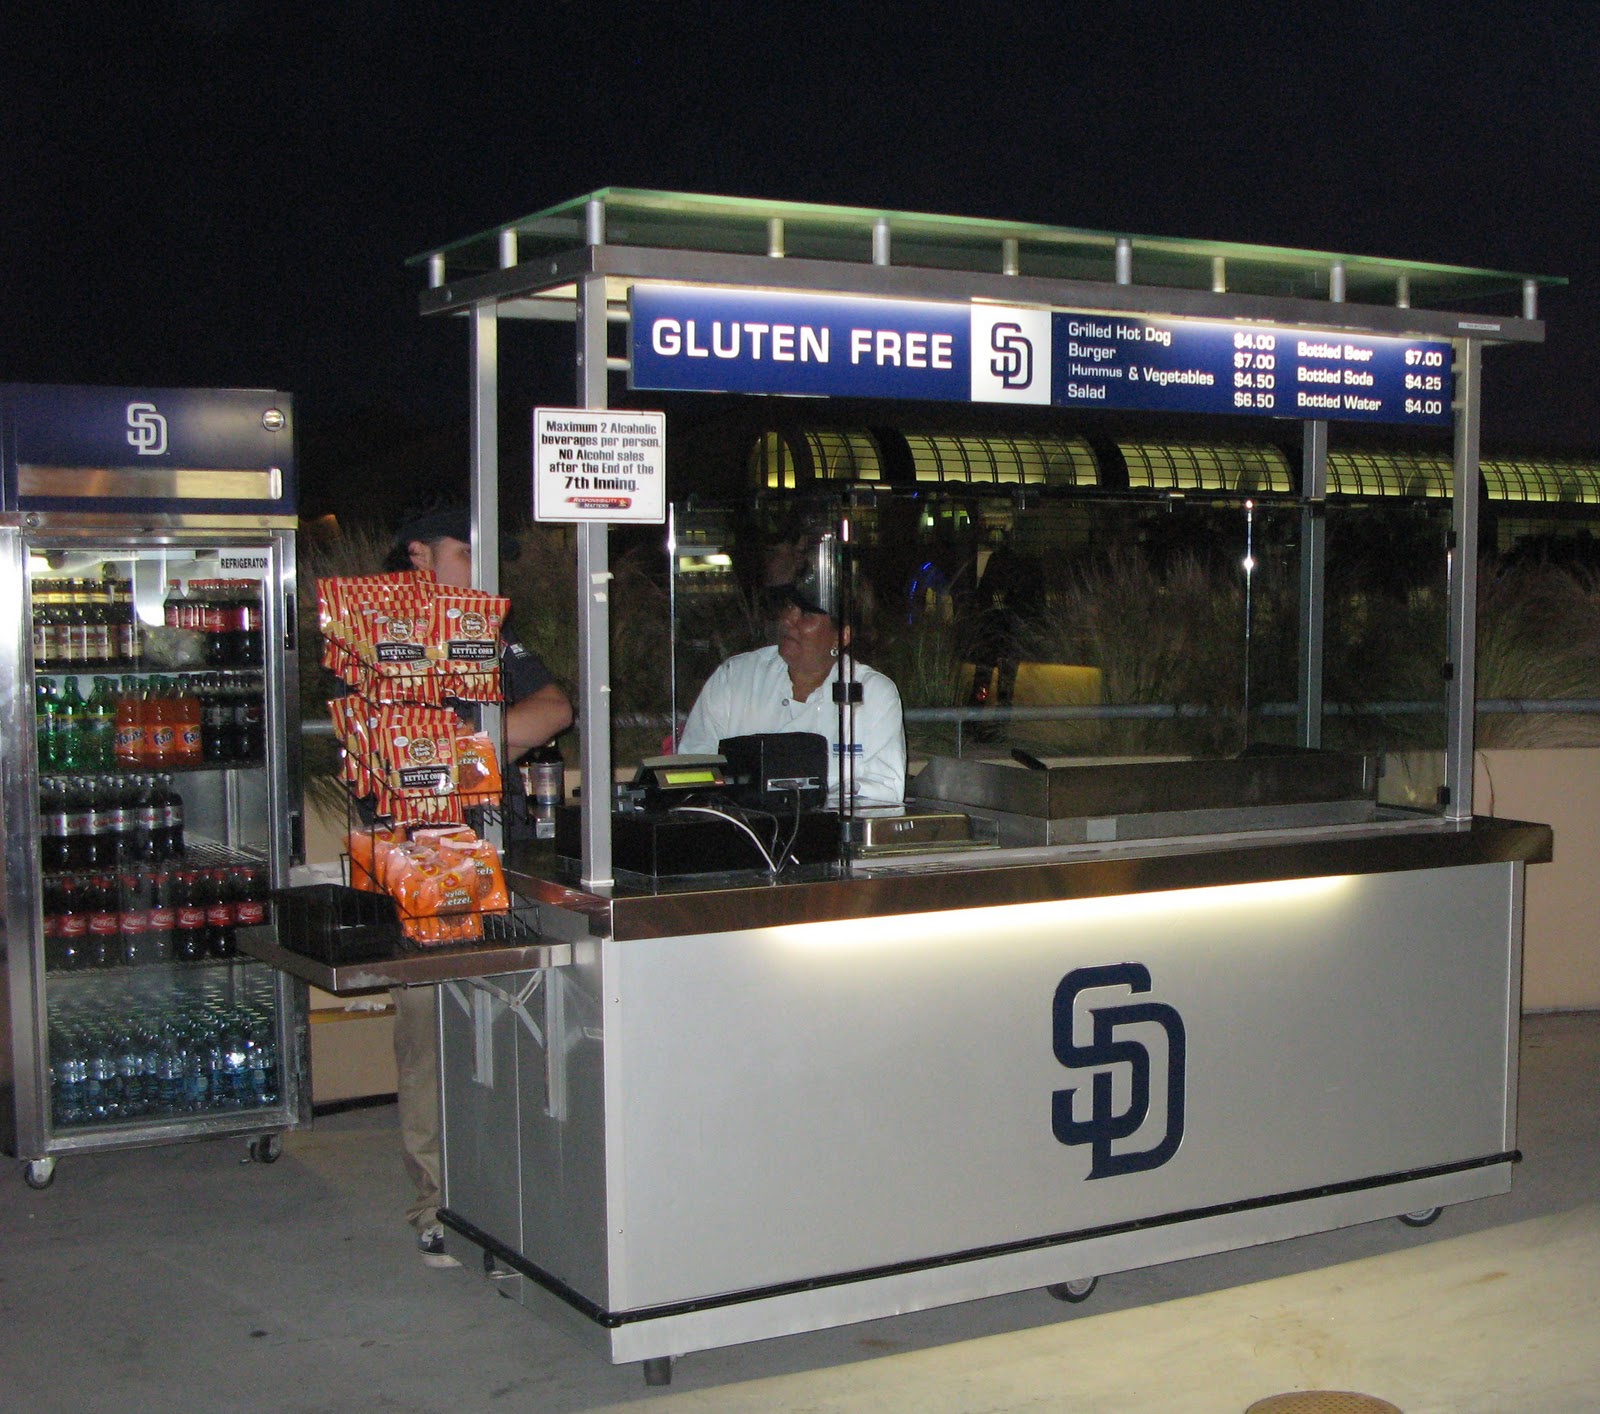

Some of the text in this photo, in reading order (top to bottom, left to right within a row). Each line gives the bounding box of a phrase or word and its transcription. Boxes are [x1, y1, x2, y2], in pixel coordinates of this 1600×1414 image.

[1068, 321, 1171, 346] Grilled Hot Dog
[1233, 332, 1276, 351] $4.00
[652, 318, 953, 369] GLUTEN FREE
[1068, 342, 1116, 362] Burger
[1297, 341, 1373, 361] Bottled Beer
[1233, 352, 1276, 370] $7.00
[1404, 349, 1443, 367] $7.00
[1071, 363, 1214, 386] Hummus & Vegetables
[1233, 372, 1275, 389] $4.50
[1297, 366, 1374, 387] Bottled Soda
[1404, 374, 1442, 391] $4.25
[1067, 383, 1106, 400] Salad
[1233, 391, 1275, 409] $6.50
[1297, 392, 1382, 412] Bottled Water
[1404, 400, 1442, 415] $4.00
[546, 420, 657, 435] Maximum 2 Alcoholic
[541, 433, 661, 448] beverages per person.
[558, 448, 645, 462] NO Alcohol sales
[549, 461, 654, 475] after the End of the
[564, 476, 640, 492] 7th Inning.
[220, 557, 269, 569] REFRIGERATOR
[452, 647, 494, 655] KETTLE CORN
[404, 773, 429, 783] KETTLE
